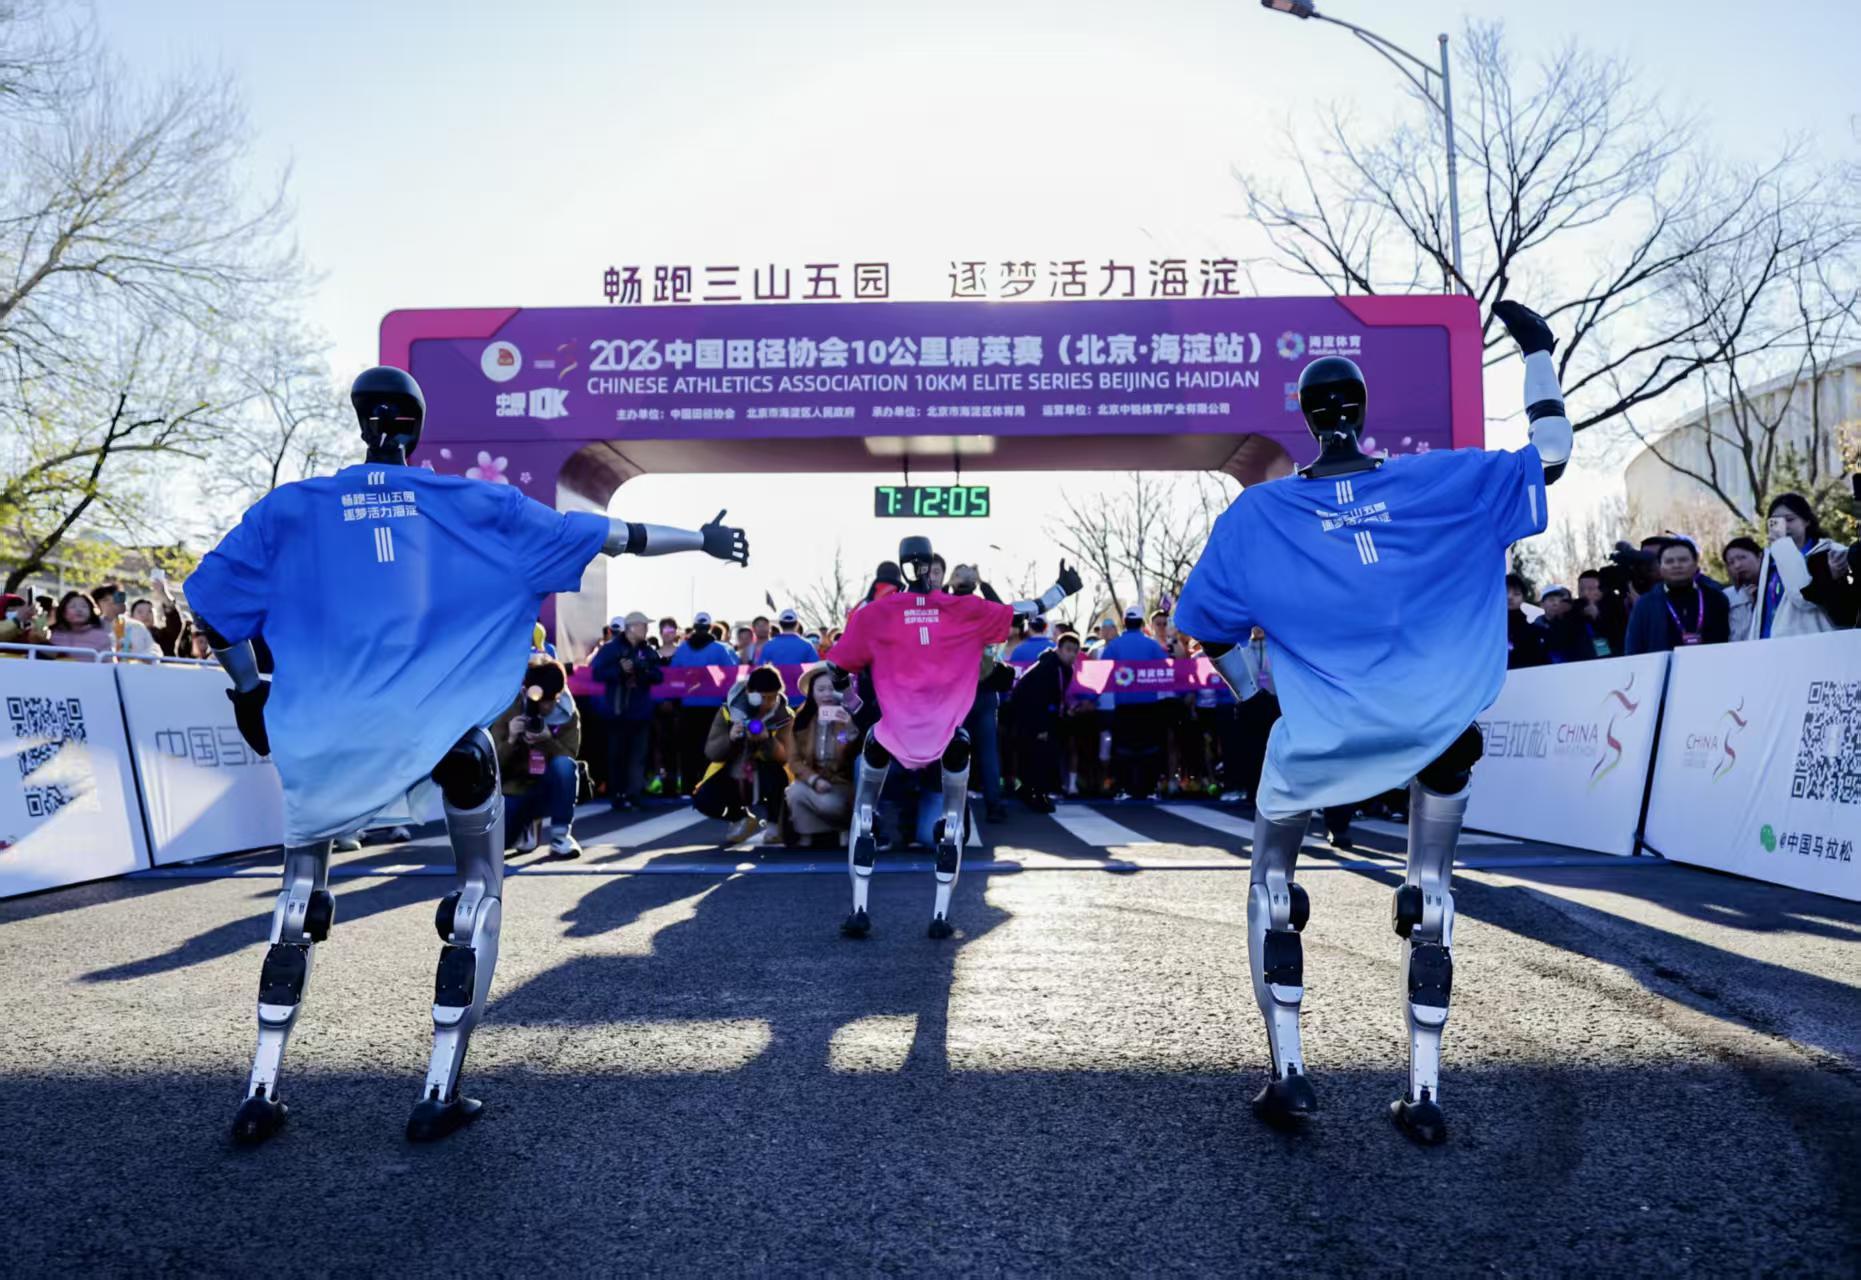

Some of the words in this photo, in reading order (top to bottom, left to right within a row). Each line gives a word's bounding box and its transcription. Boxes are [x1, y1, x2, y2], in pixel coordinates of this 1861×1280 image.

[603, 262, 889, 304] 畅跑三山五园
[948, 257, 1240, 298] 逐梦活力海淀
[587, 377, 668, 394] CHINESE
[673, 375, 773, 393] ATHLETICS
[778, 374, 908, 392] ASSOCIATION
[915, 374, 967, 391] 10KM
[973, 373, 1023, 391] ELITE
[1028, 372, 1093, 390] SERIES
[1100, 371, 1170, 392] BEIJING
[1176, 370, 1260, 388] HAIDIAN
[1557, 723, 1599, 744] CHINA
[1686, 733, 1719, 750] CHINA
